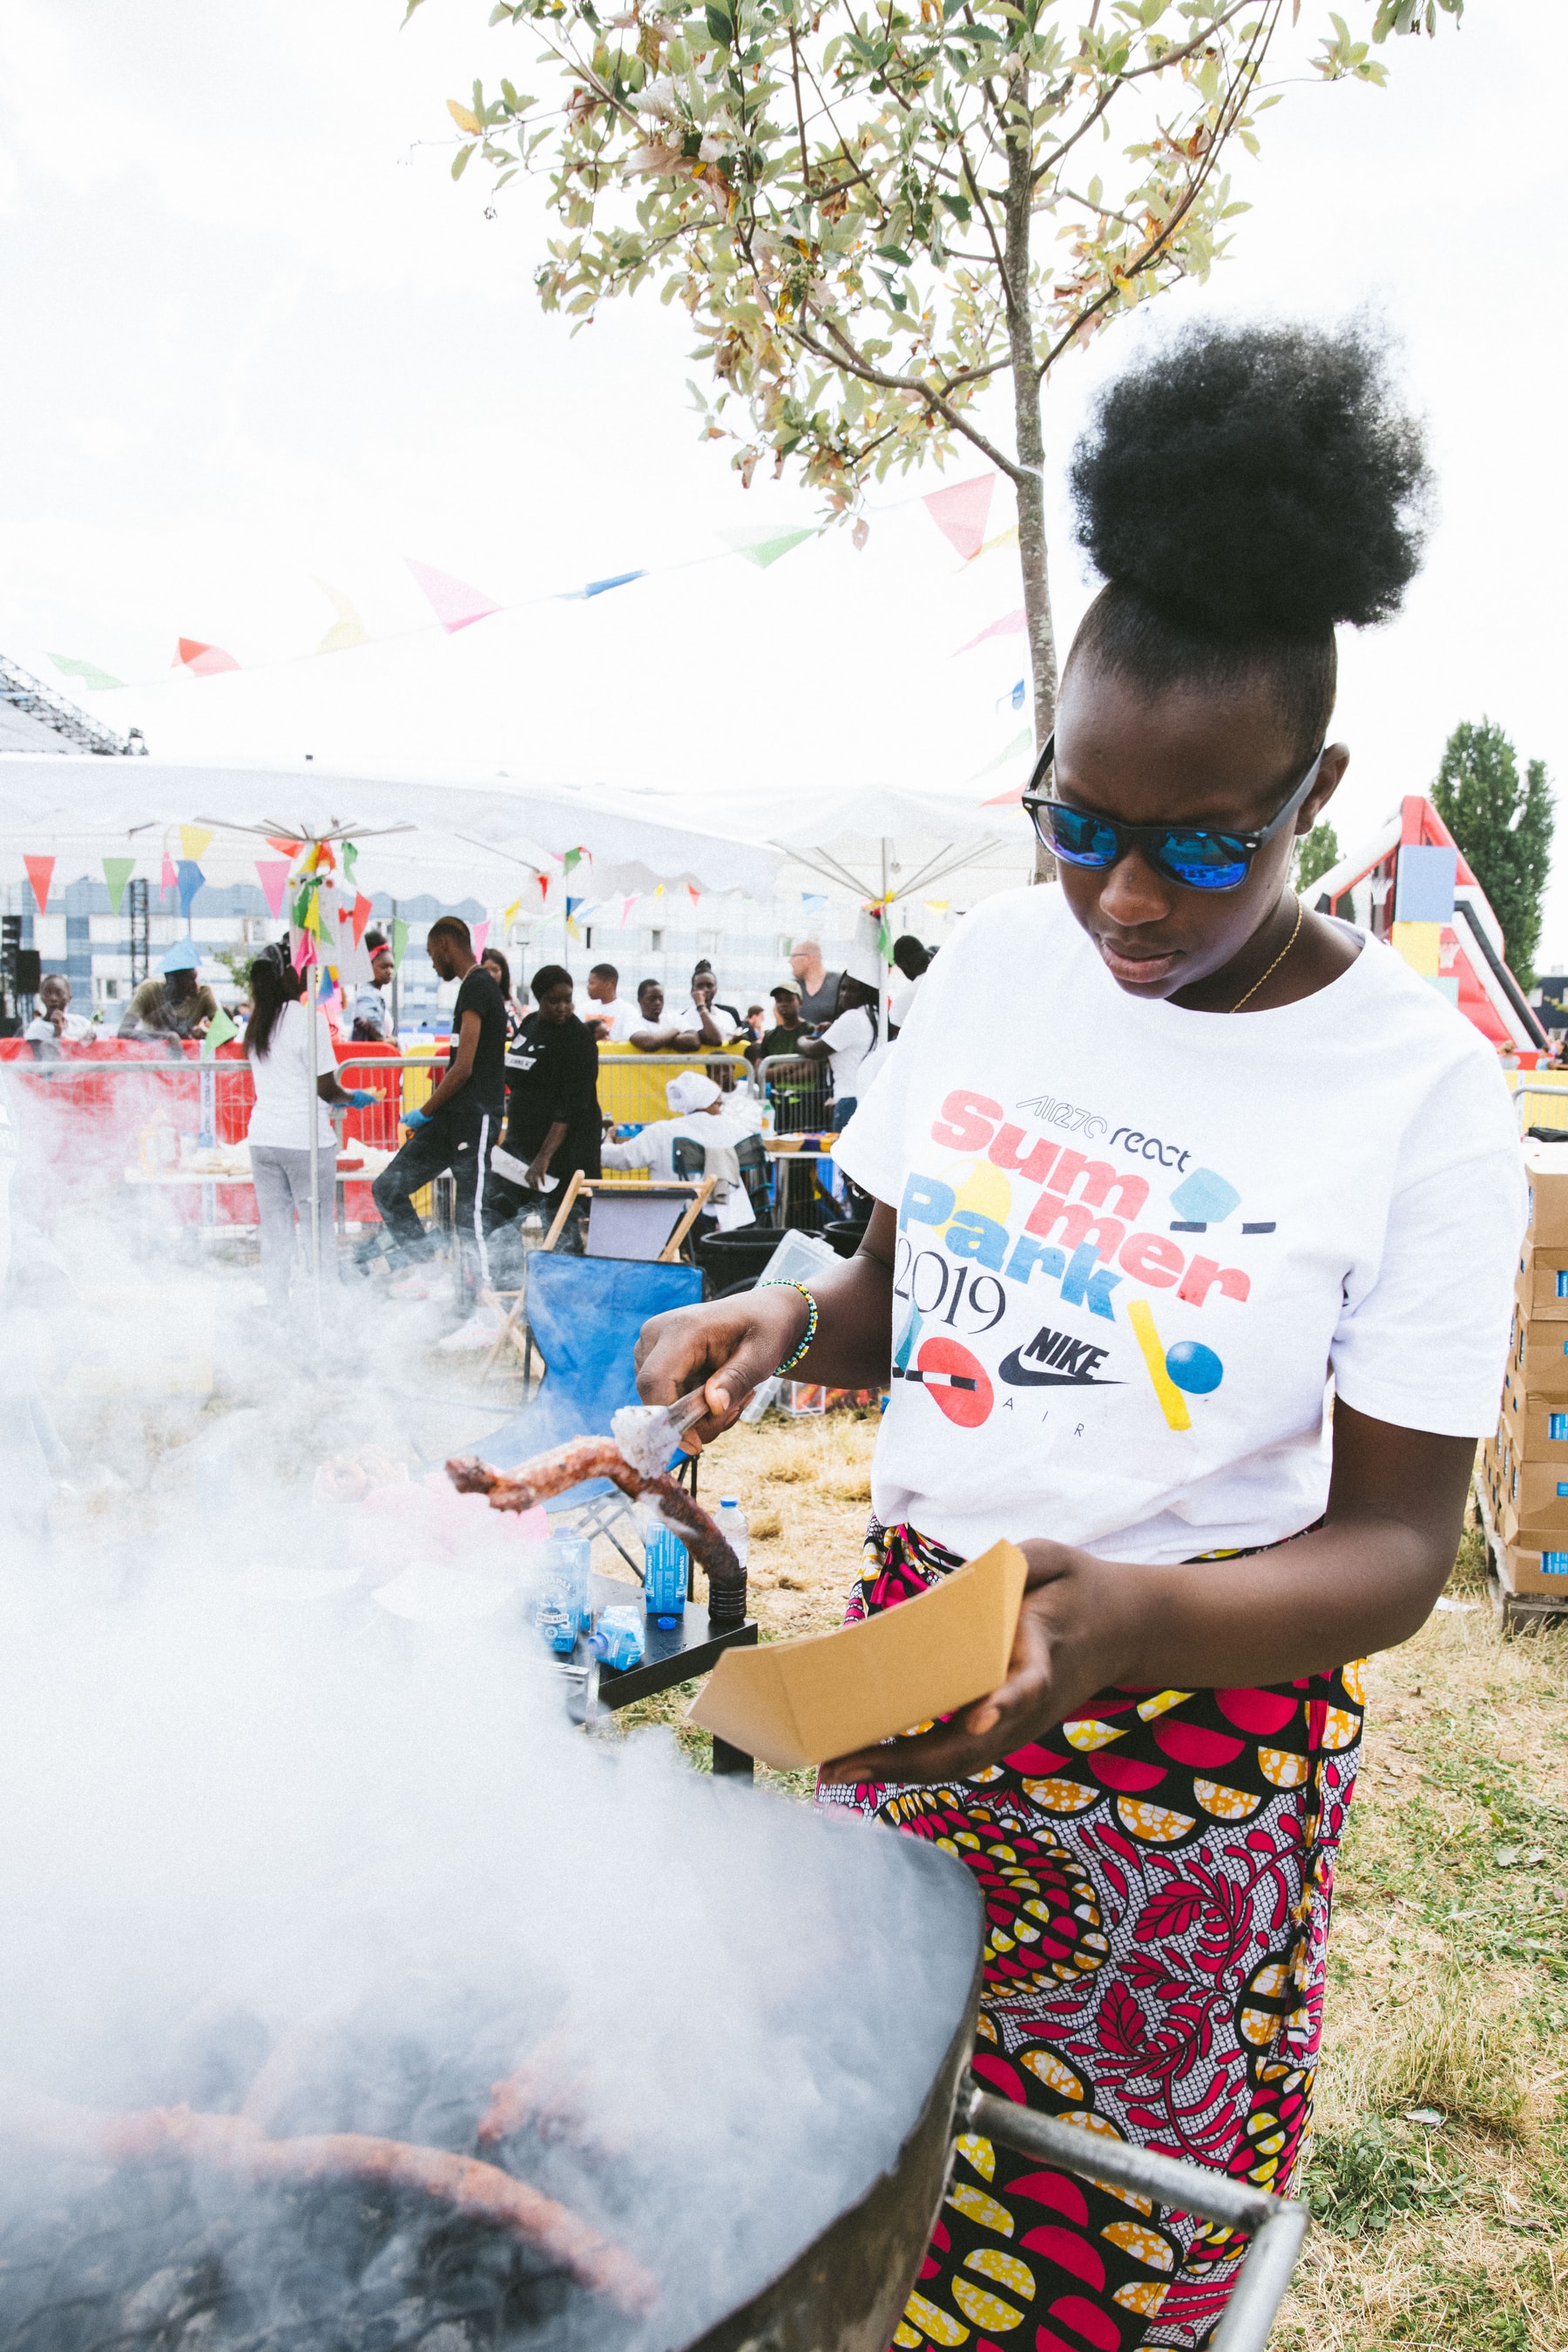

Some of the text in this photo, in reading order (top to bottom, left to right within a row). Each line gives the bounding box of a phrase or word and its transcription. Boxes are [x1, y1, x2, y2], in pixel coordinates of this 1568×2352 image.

[930, 1089, 1151, 1221] Sum
[1109, 1127, 1192, 1173] react
[894, 1237, 1006, 1335] 2019
[898, 1171, 1124, 1322] Park
[1023, 1191, 1251, 1308] mer
[1024, 1326, 1110, 1381] NIKE
